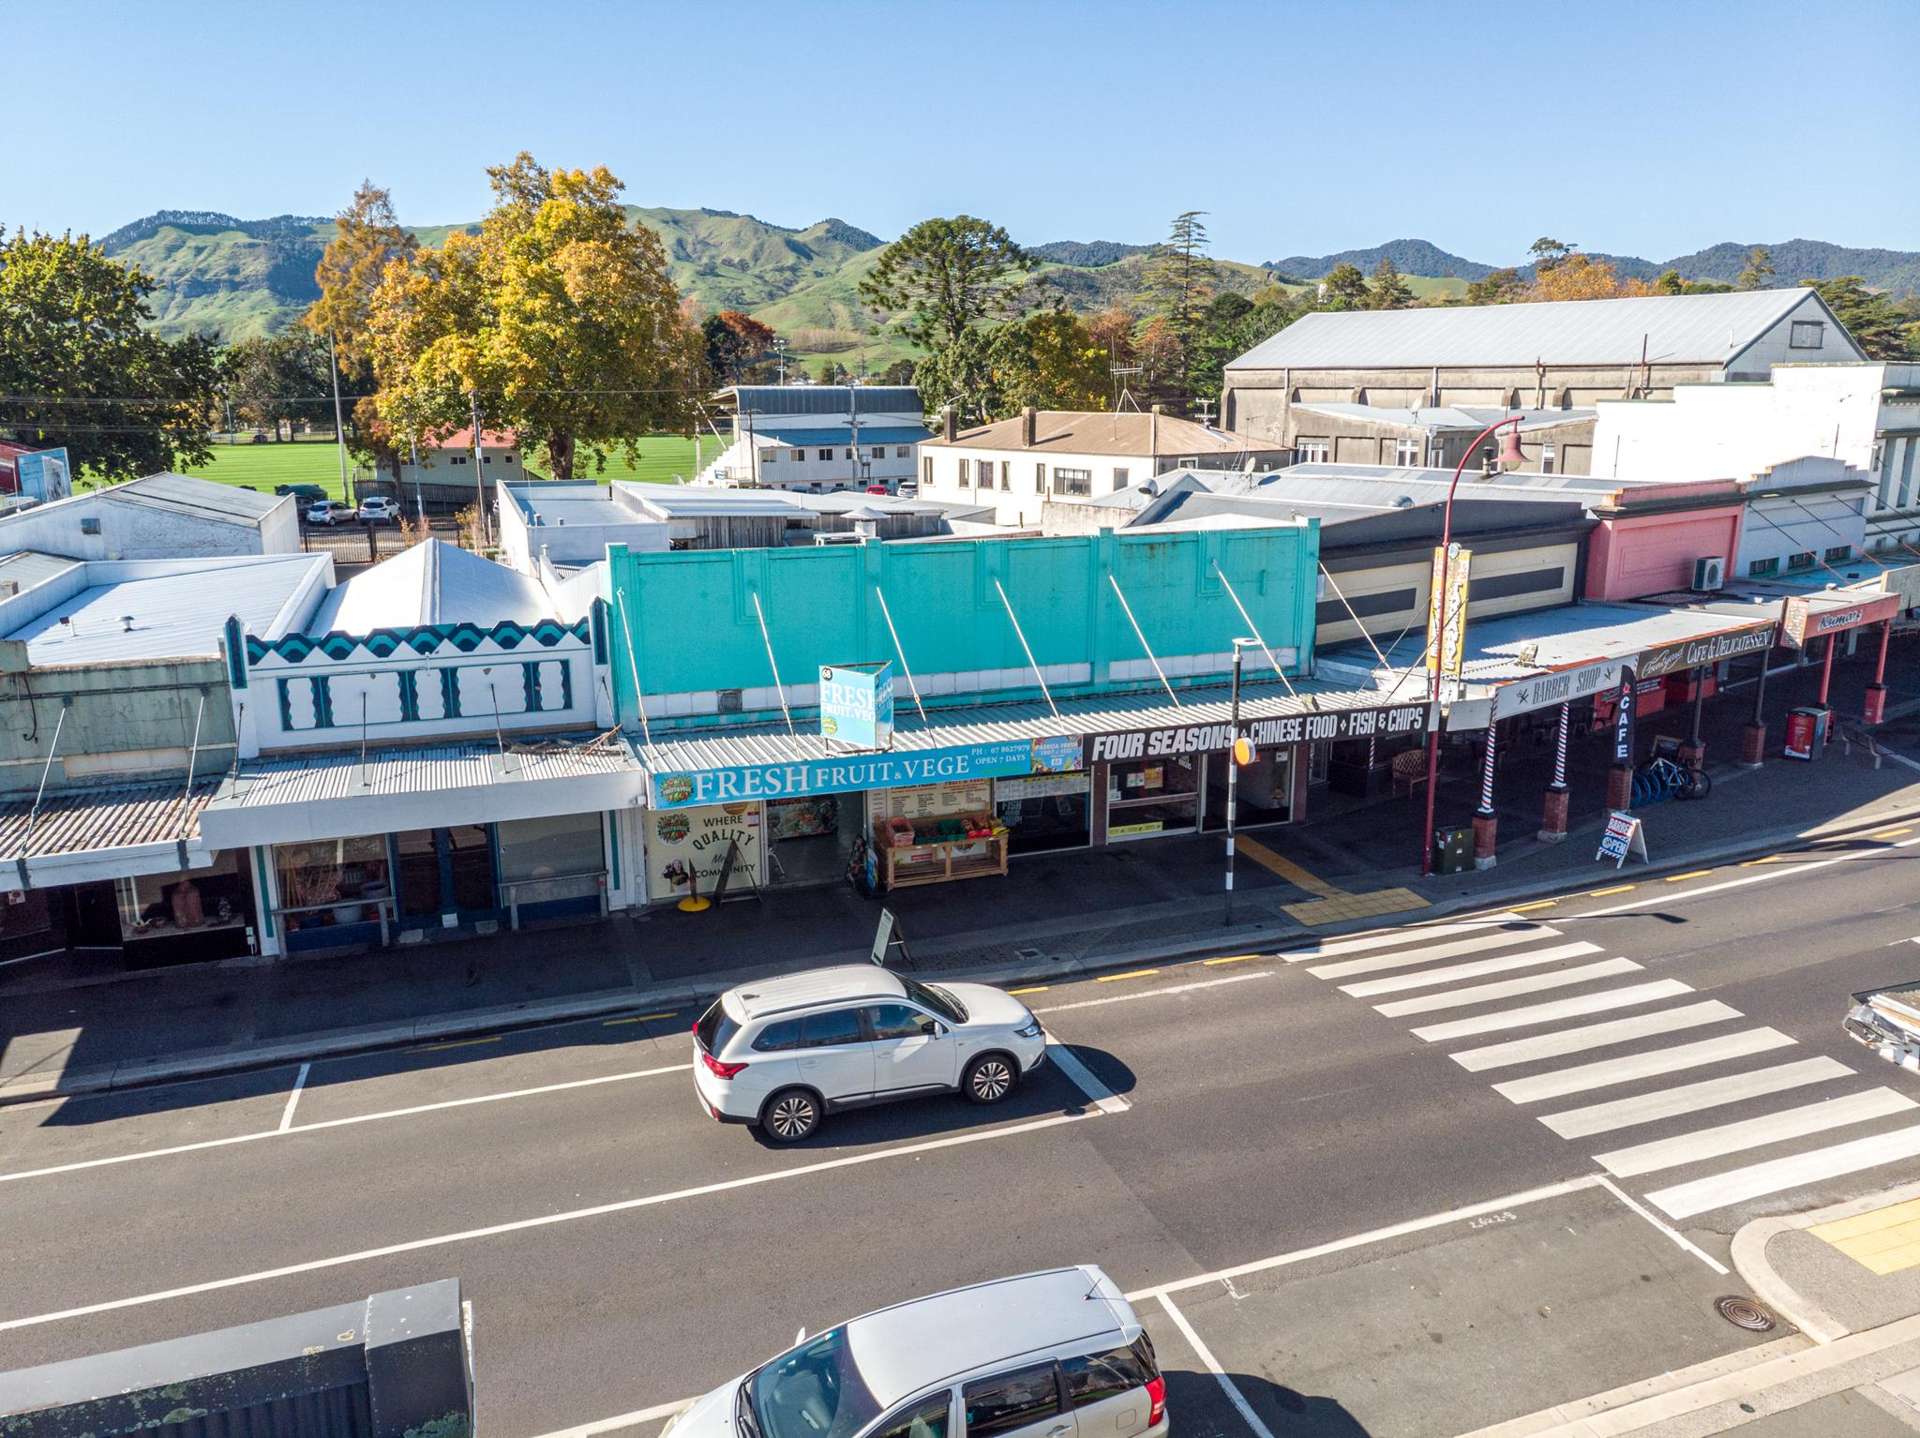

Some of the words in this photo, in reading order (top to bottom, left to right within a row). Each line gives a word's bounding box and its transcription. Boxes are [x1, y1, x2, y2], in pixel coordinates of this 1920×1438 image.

[1532, 674, 1570, 705] BARBER
[1576, 666, 1602, 693] SHOP
[1091, 731, 1146, 762] FOUR
[1250, 717, 1304, 745] CHINESE
[1305, 714, 1338, 741] FOOD
[1348, 710, 1377, 736] FISH
[1378, 715, 1387, 728] &
[1388, 706, 1424, 732] CHIPS
[1617, 696, 1630, 758] CAFE
[694, 765, 811, 801] FRESH
[814, 762, 894, 788] FRUIT
[894, 773, 903, 781] &
[903, 755, 969, 779] VEGE
[975, 756, 998, 765] OPEN
[1006, 753, 1026, 763] DAYS
[692, 828, 755, 851] QUALITY
[703, 815, 743, 828] WHERE
